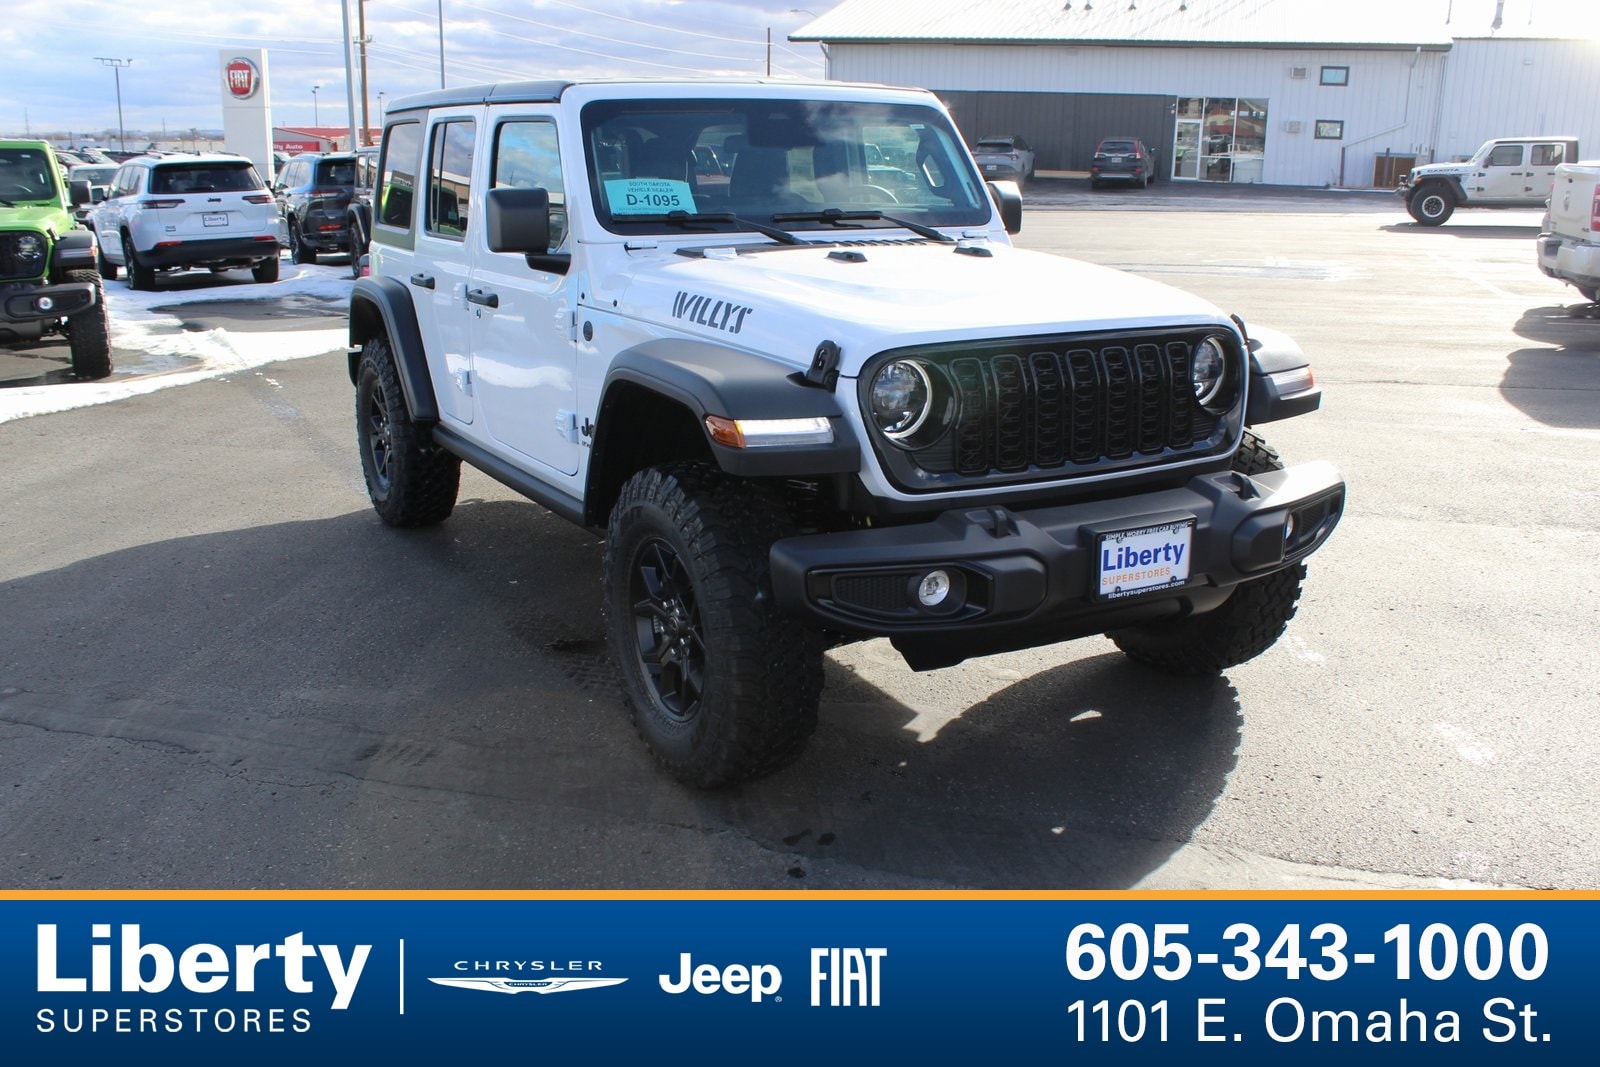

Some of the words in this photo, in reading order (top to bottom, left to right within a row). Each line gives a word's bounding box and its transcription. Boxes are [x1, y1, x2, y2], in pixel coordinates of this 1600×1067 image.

[229, 69, 250, 88] FIAT
[626, 193, 680, 206] D-1095
[672, 290, 754, 334] WILLYS
[1102, 542, 1185, 572] Liberty
[1101, 566, 1171, 587] SUPERSTORES
[1107, 580, 1185, 599] libertysuperstores.com
